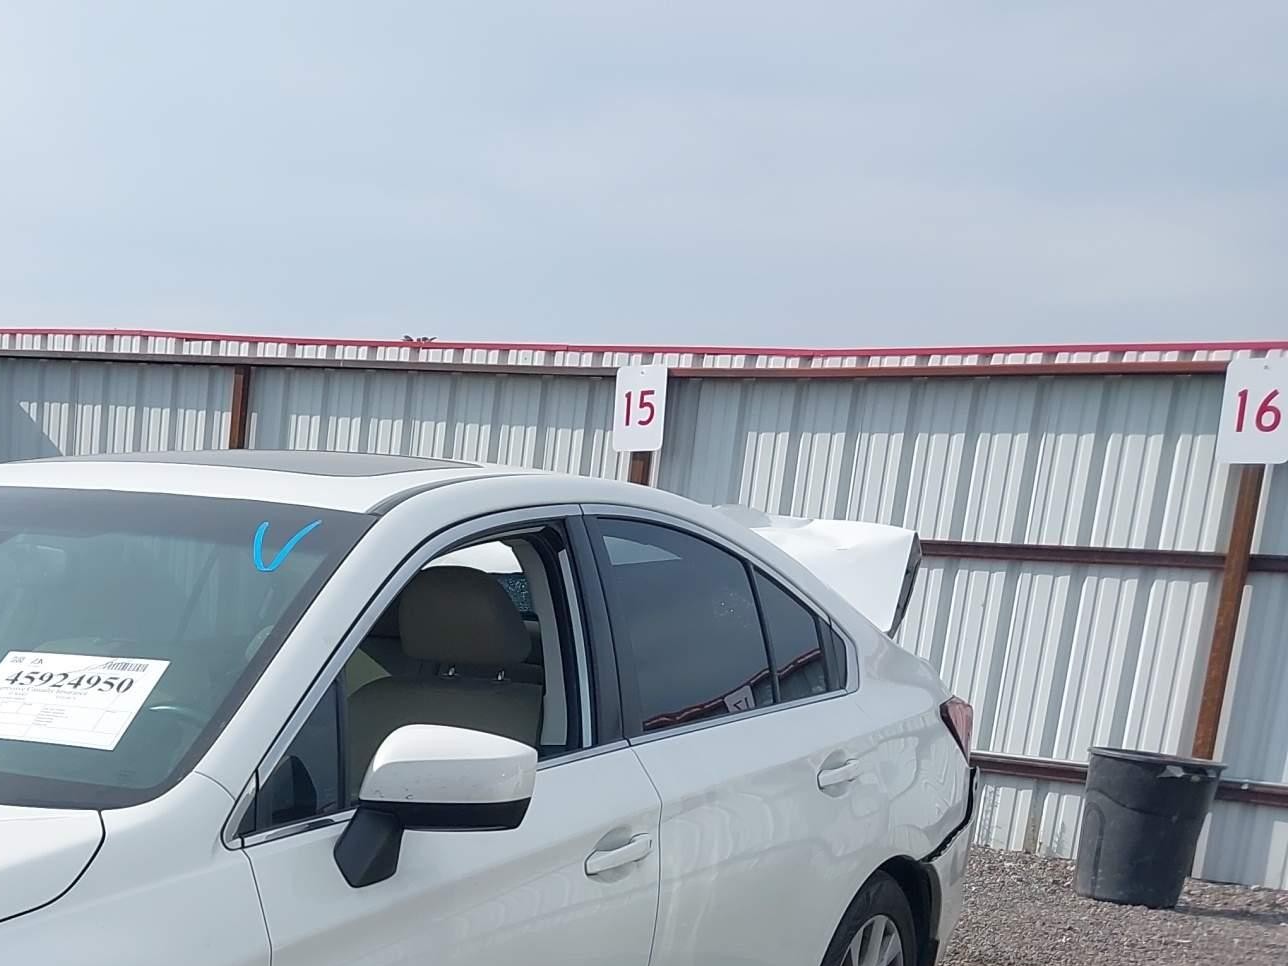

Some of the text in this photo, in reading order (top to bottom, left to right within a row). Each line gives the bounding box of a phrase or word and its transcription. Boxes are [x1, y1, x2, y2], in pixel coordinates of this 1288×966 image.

[624, 389, 655, 427] 15
[1235, 388, 1282, 433] 16
[5, 669, 134, 694] 45924950
